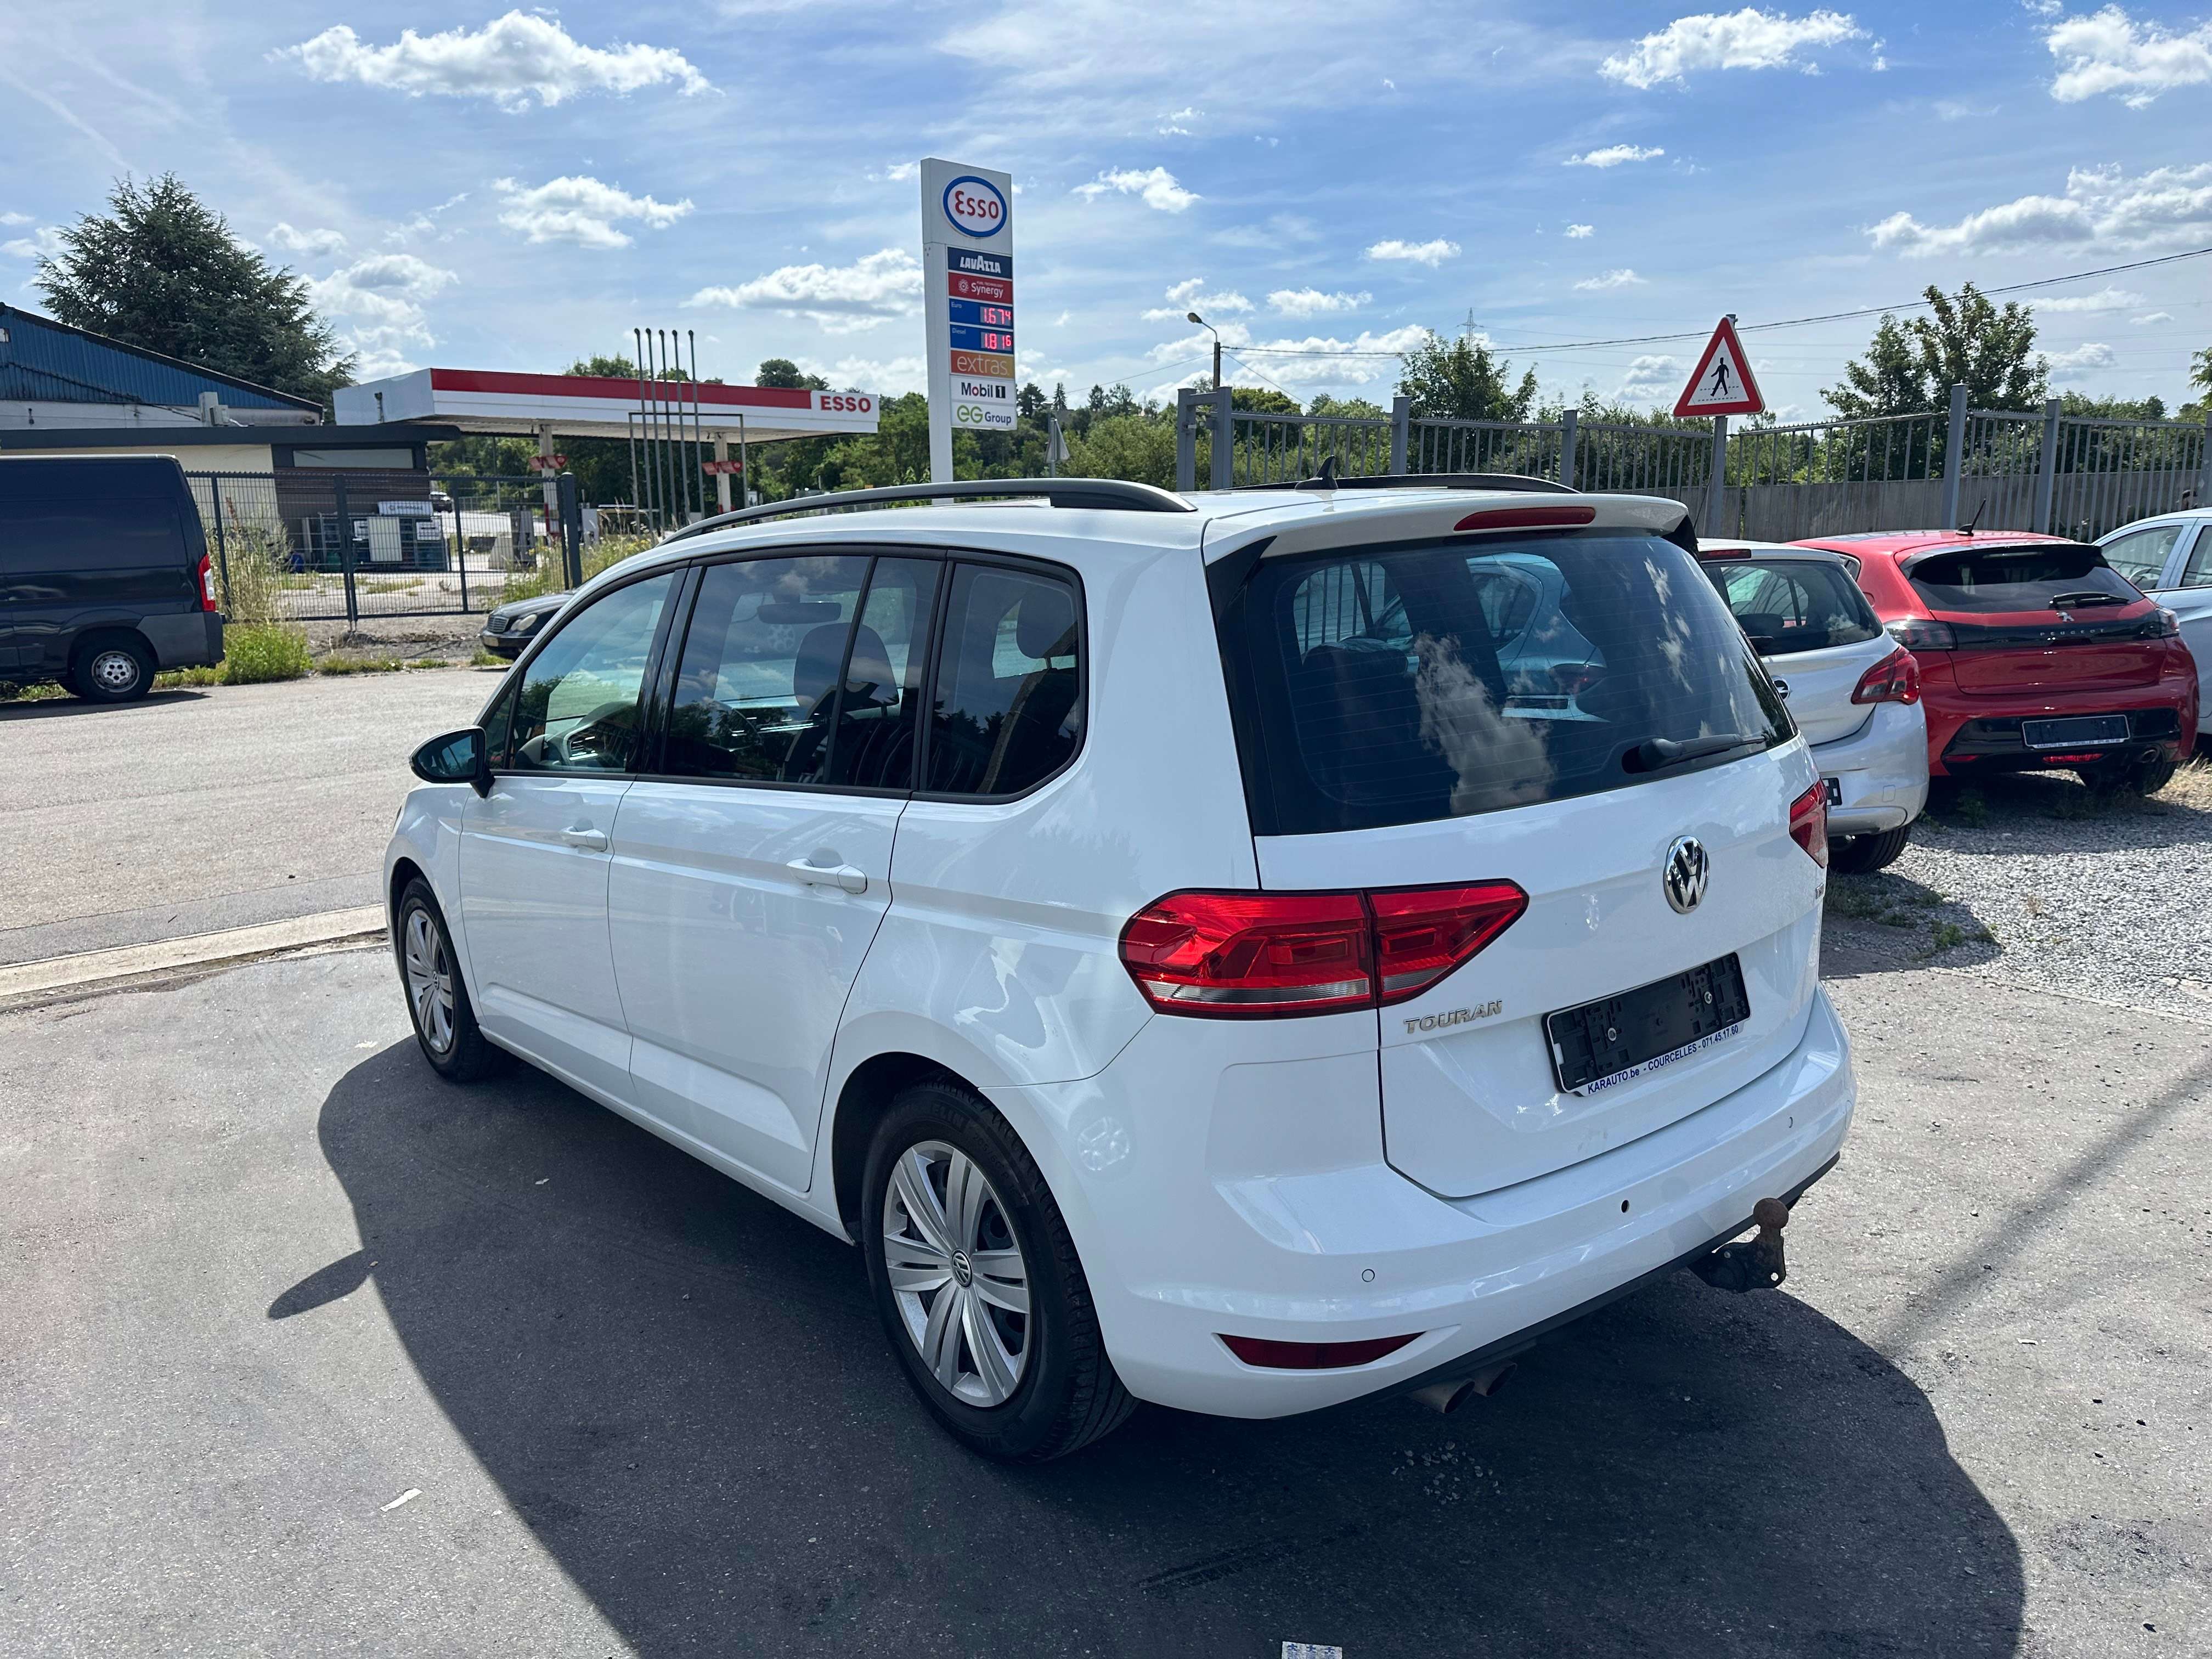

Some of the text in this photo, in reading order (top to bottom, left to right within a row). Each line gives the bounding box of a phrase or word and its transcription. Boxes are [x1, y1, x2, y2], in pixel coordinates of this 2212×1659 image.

[960, 256, 1001, 274] LAVAZZA
[971, 283, 1003, 298] Synergy
[957, 356, 1008, 376] extras
[961, 382, 993, 398] Mobil
[821, 396, 871, 413] ESSO
[985, 412, 1011, 426] Group
[1404, 998, 1502, 1034] TOURAN
[1588, 1068, 1640, 1094] KARAUTO.be
[1648, 1043, 1697, 1071] COURCELLES
[1702, 1024, 1739, 1048] 071.45.17.60
